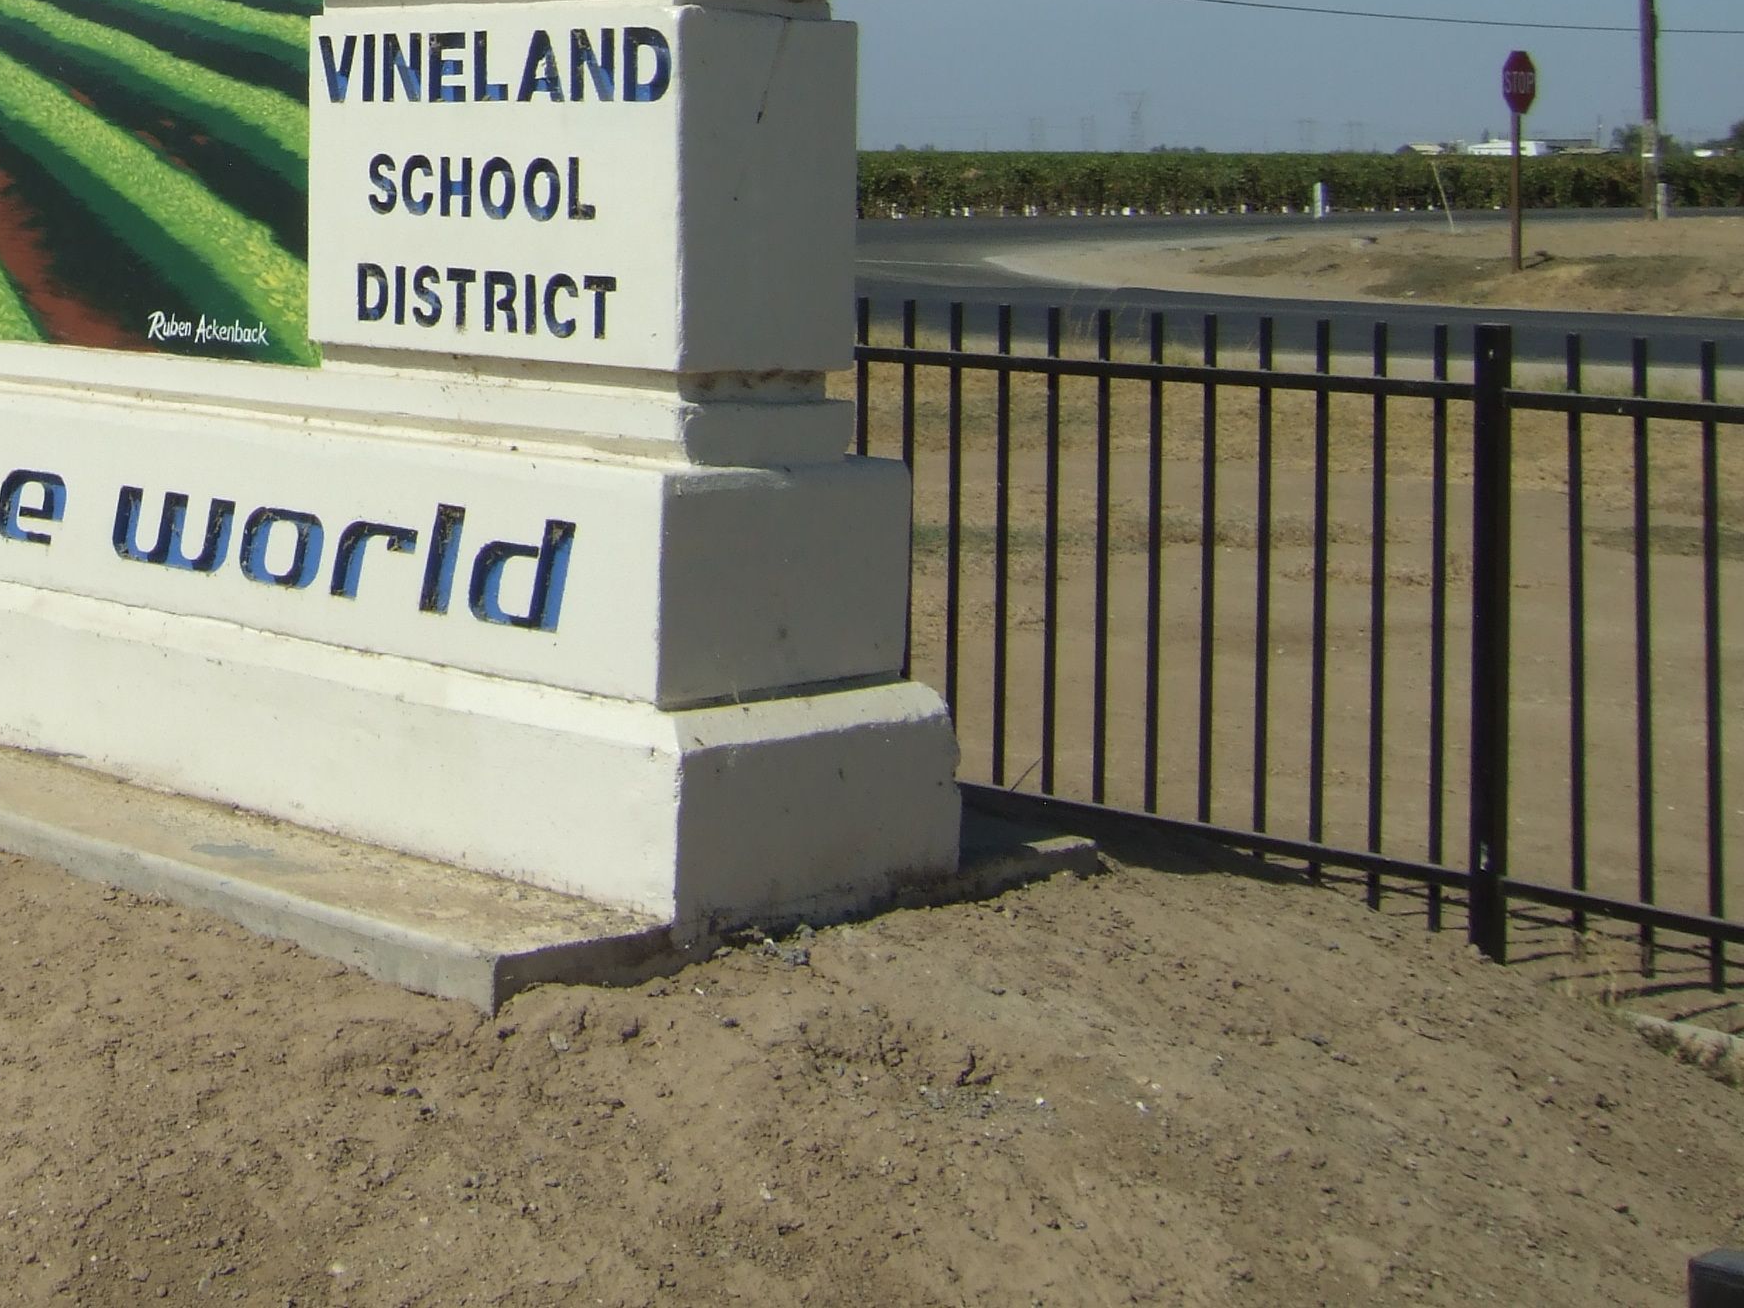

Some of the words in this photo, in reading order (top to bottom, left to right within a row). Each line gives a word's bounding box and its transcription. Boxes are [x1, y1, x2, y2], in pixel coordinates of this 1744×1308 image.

[319, 27, 672, 104] VINELAND
[1504, 71, 1534, 94] STOP
[368, 153, 596, 222] SCHOOL
[147, 310, 192, 342] Ruben
[194, 313, 270, 347] Ackenback
[357, 263, 617, 340] DISTRICT
[111, 484, 577, 634] world
